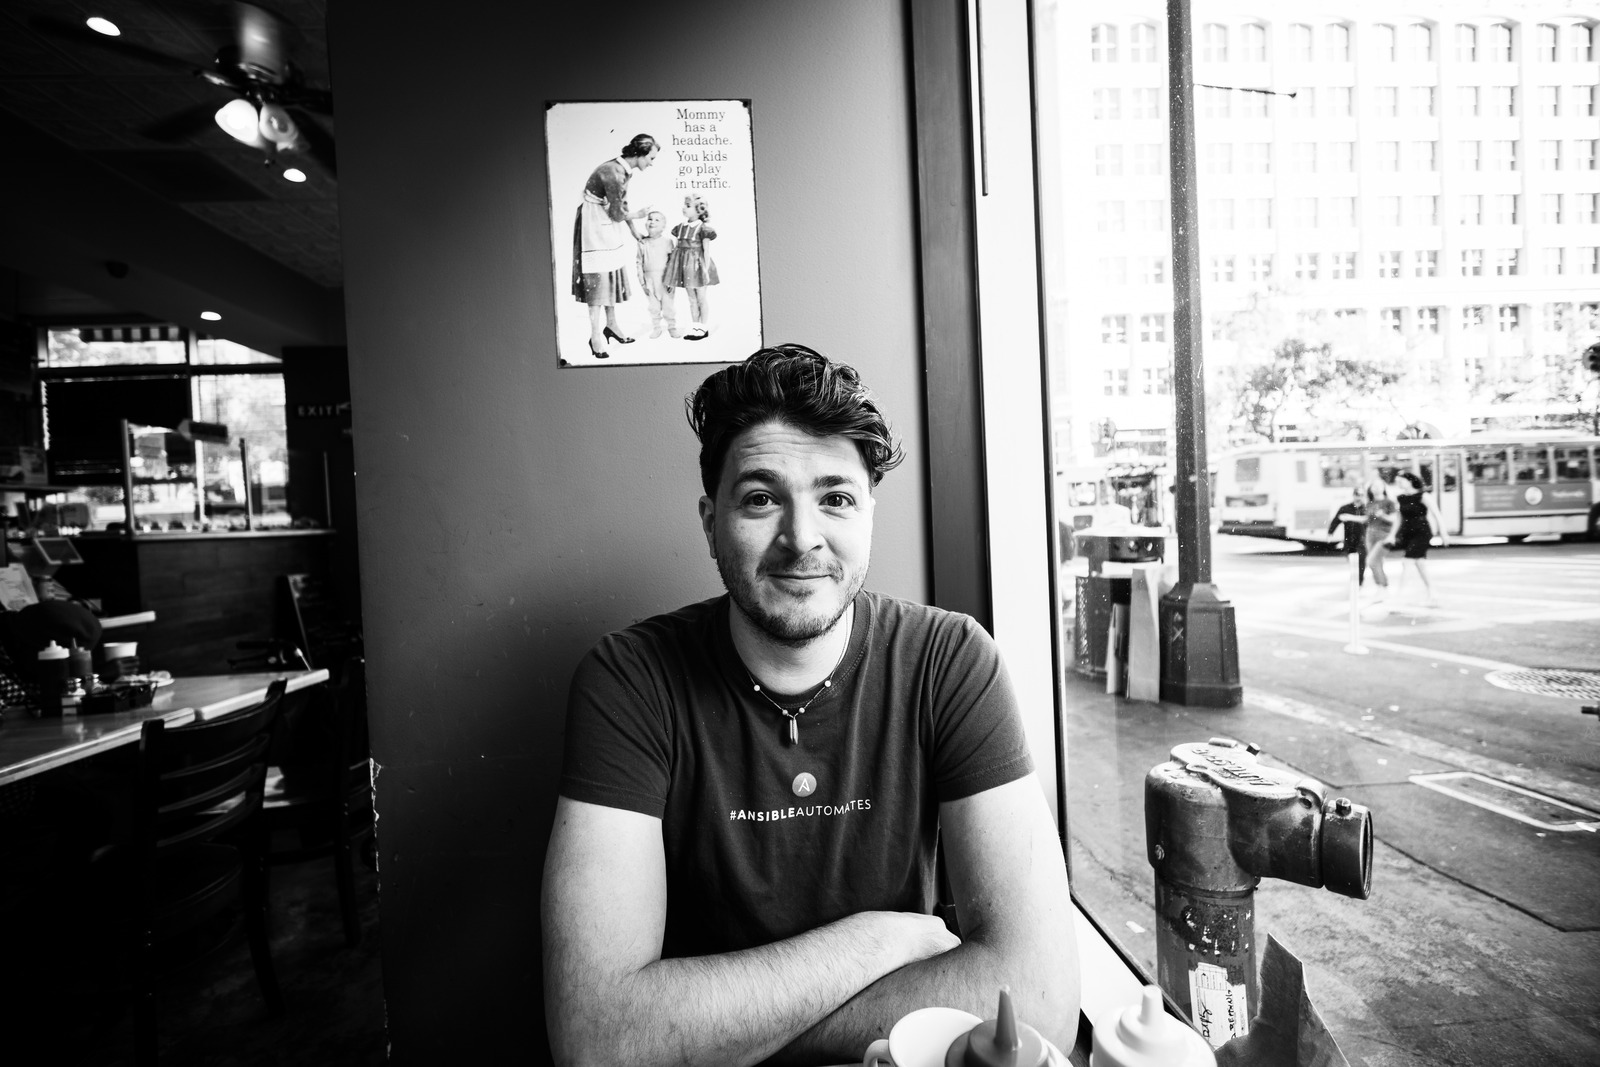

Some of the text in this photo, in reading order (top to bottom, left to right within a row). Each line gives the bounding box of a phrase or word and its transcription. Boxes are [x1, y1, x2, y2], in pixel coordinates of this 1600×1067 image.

[677, 108, 726, 122] Mommy
[684, 121, 717, 132] has a
[672, 134, 733, 145] headache.
[676, 150, 728, 161] You kids
[678, 163, 721, 176] go play
[675, 177, 731, 189] in traffic.
[298, 405, 332, 417] EXIT
[729, 798, 872, 822] #ANSIBLEAUTOMATES
